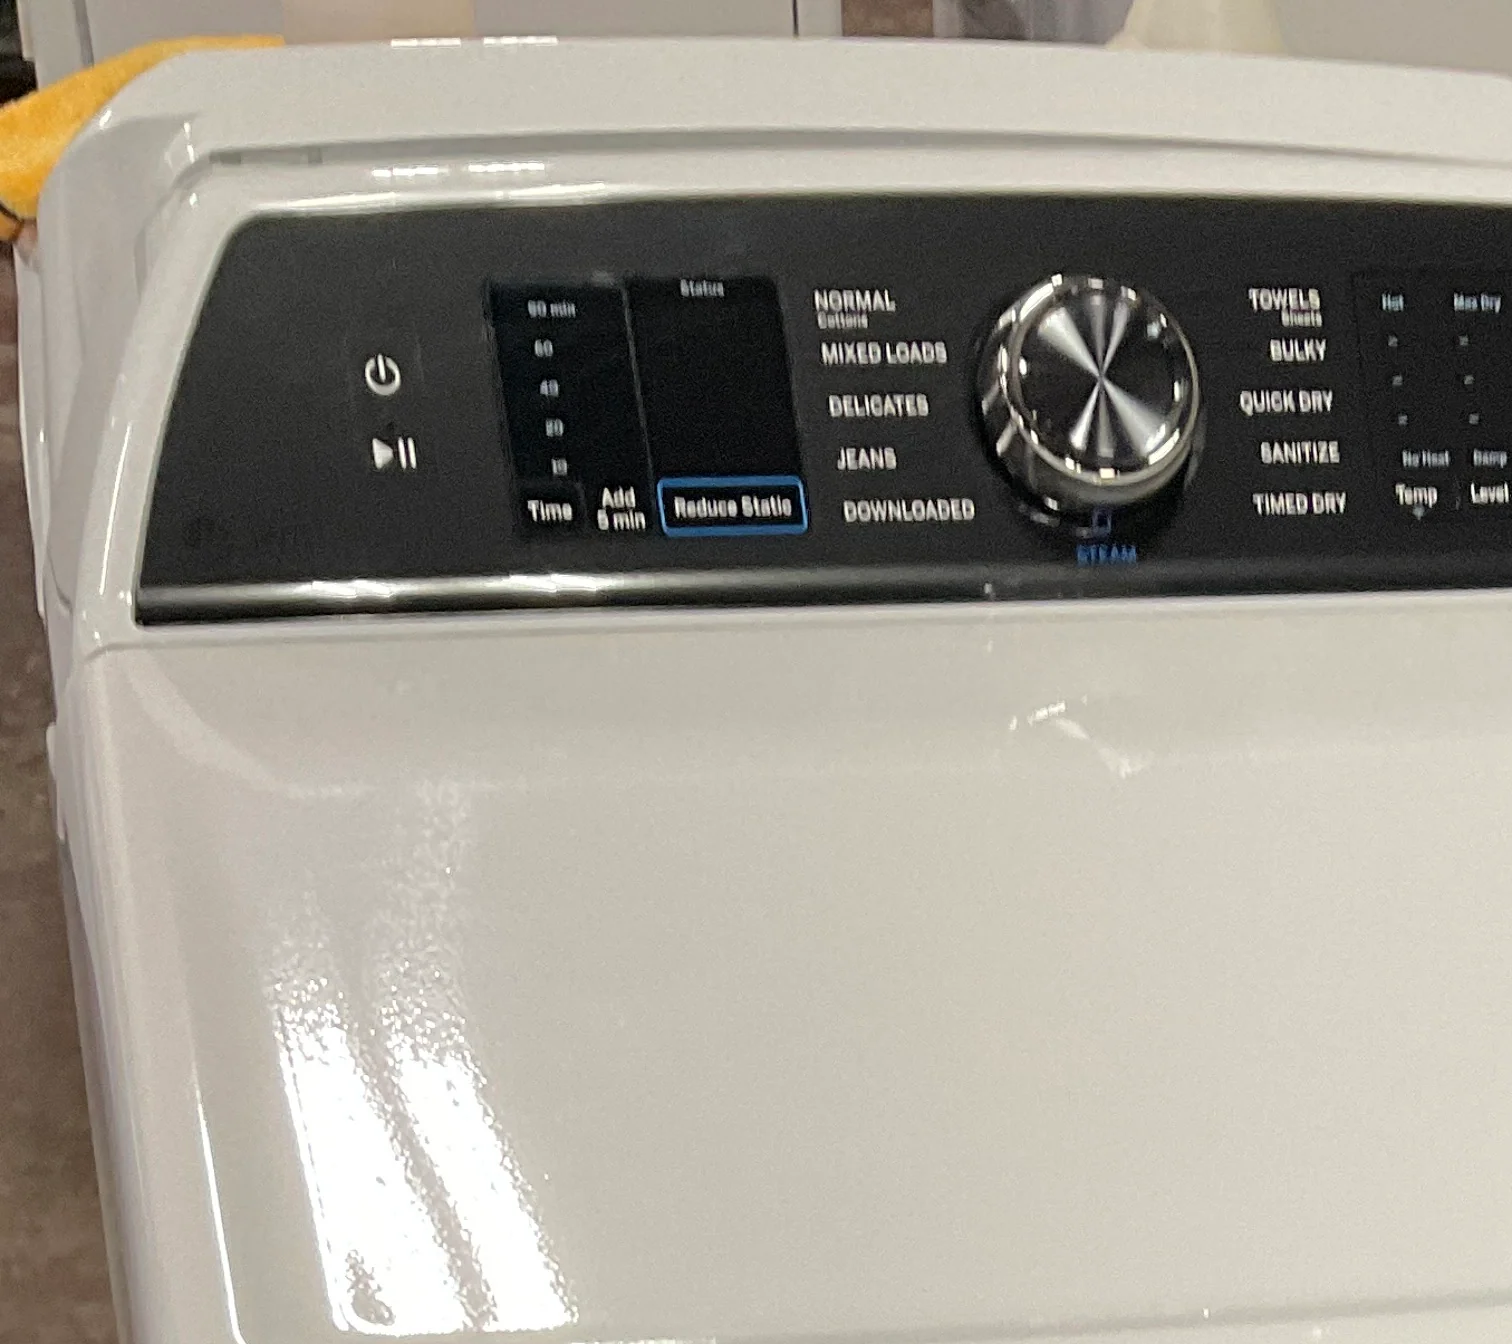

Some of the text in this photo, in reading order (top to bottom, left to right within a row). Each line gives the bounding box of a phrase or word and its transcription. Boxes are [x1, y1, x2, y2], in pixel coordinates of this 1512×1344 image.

[814, 289, 896, 312] NORMAL
[1248, 287, 1321, 311] TOWELS
[821, 341, 947, 365] MIXED LOADS
[1270, 338, 1327, 362] BULKY
[828, 393, 929, 418] DELICATES
[1239, 389, 1333, 416] QUICK DRY
[837, 447, 897, 471] JEANS
[1260, 441, 1341, 465] SANITIZE
[602, 486, 636, 509] Add
[1252, 491, 1347, 516] TIMED DRY
[1395, 483, 1438, 509] Temp
[1471, 481, 1509, 504] Level
[527, 499, 573, 522] Time
[674, 494, 793, 519] Reduce Static
[843, 499, 976, 523] DOWNLOADED
[612, 509, 647, 531] min
[1077, 543, 1138, 566] STEAM
